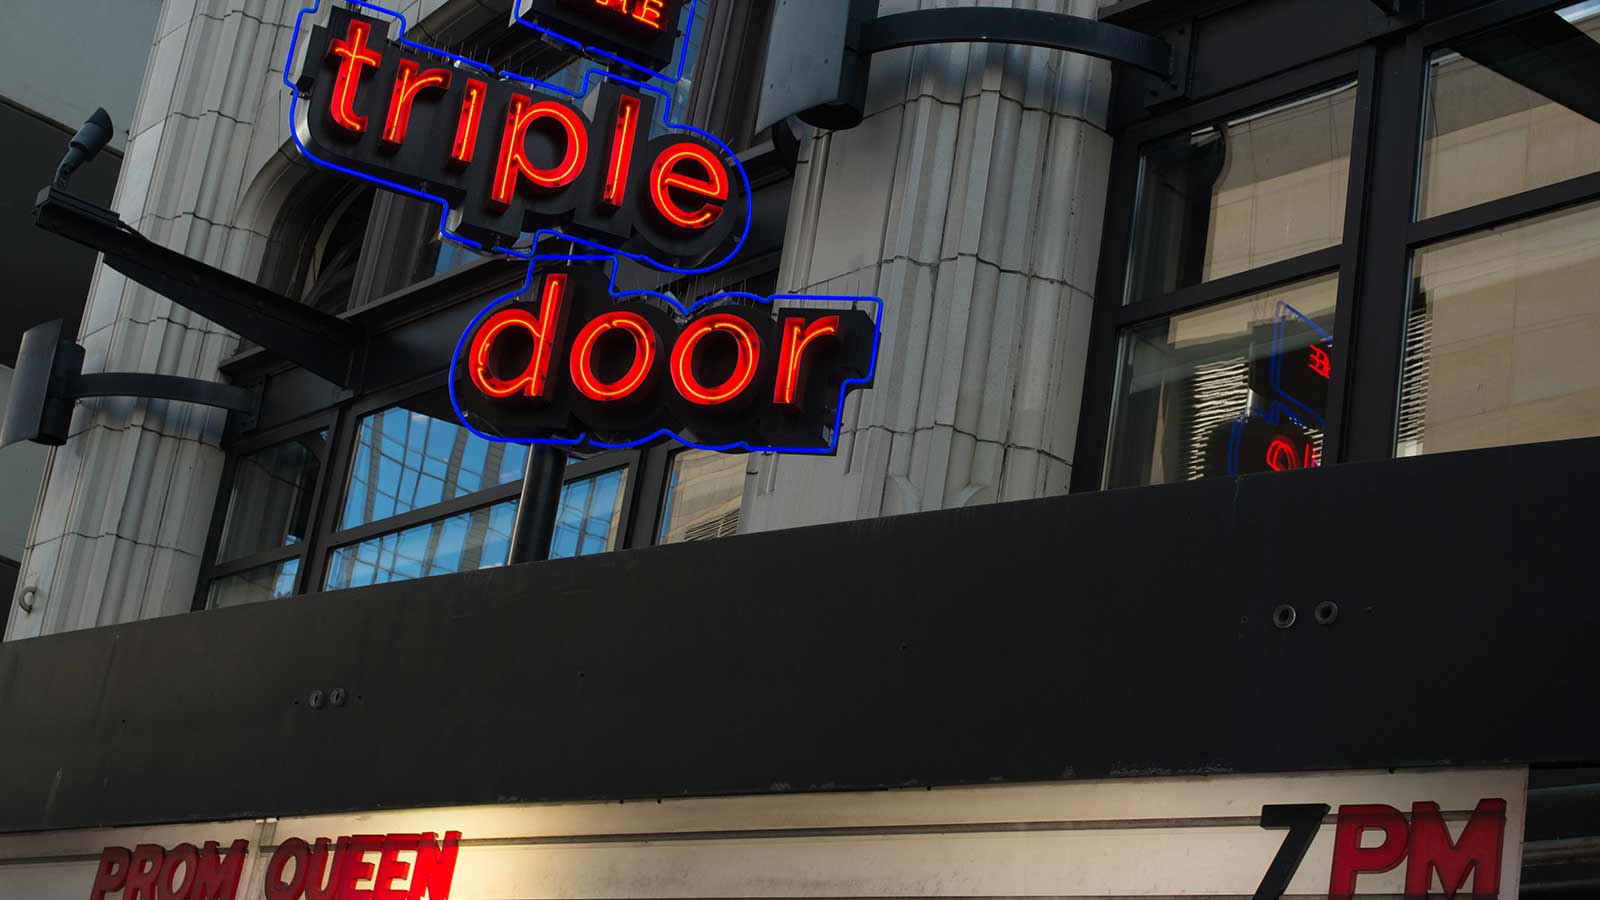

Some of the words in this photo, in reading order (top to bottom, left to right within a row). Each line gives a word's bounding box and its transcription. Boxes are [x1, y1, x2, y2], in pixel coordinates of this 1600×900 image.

[330, 19, 728, 229] triple
[468, 273, 839, 405] door
[90, 839, 249, 900] PROM
[265, 831, 461, 900] QUEEN
